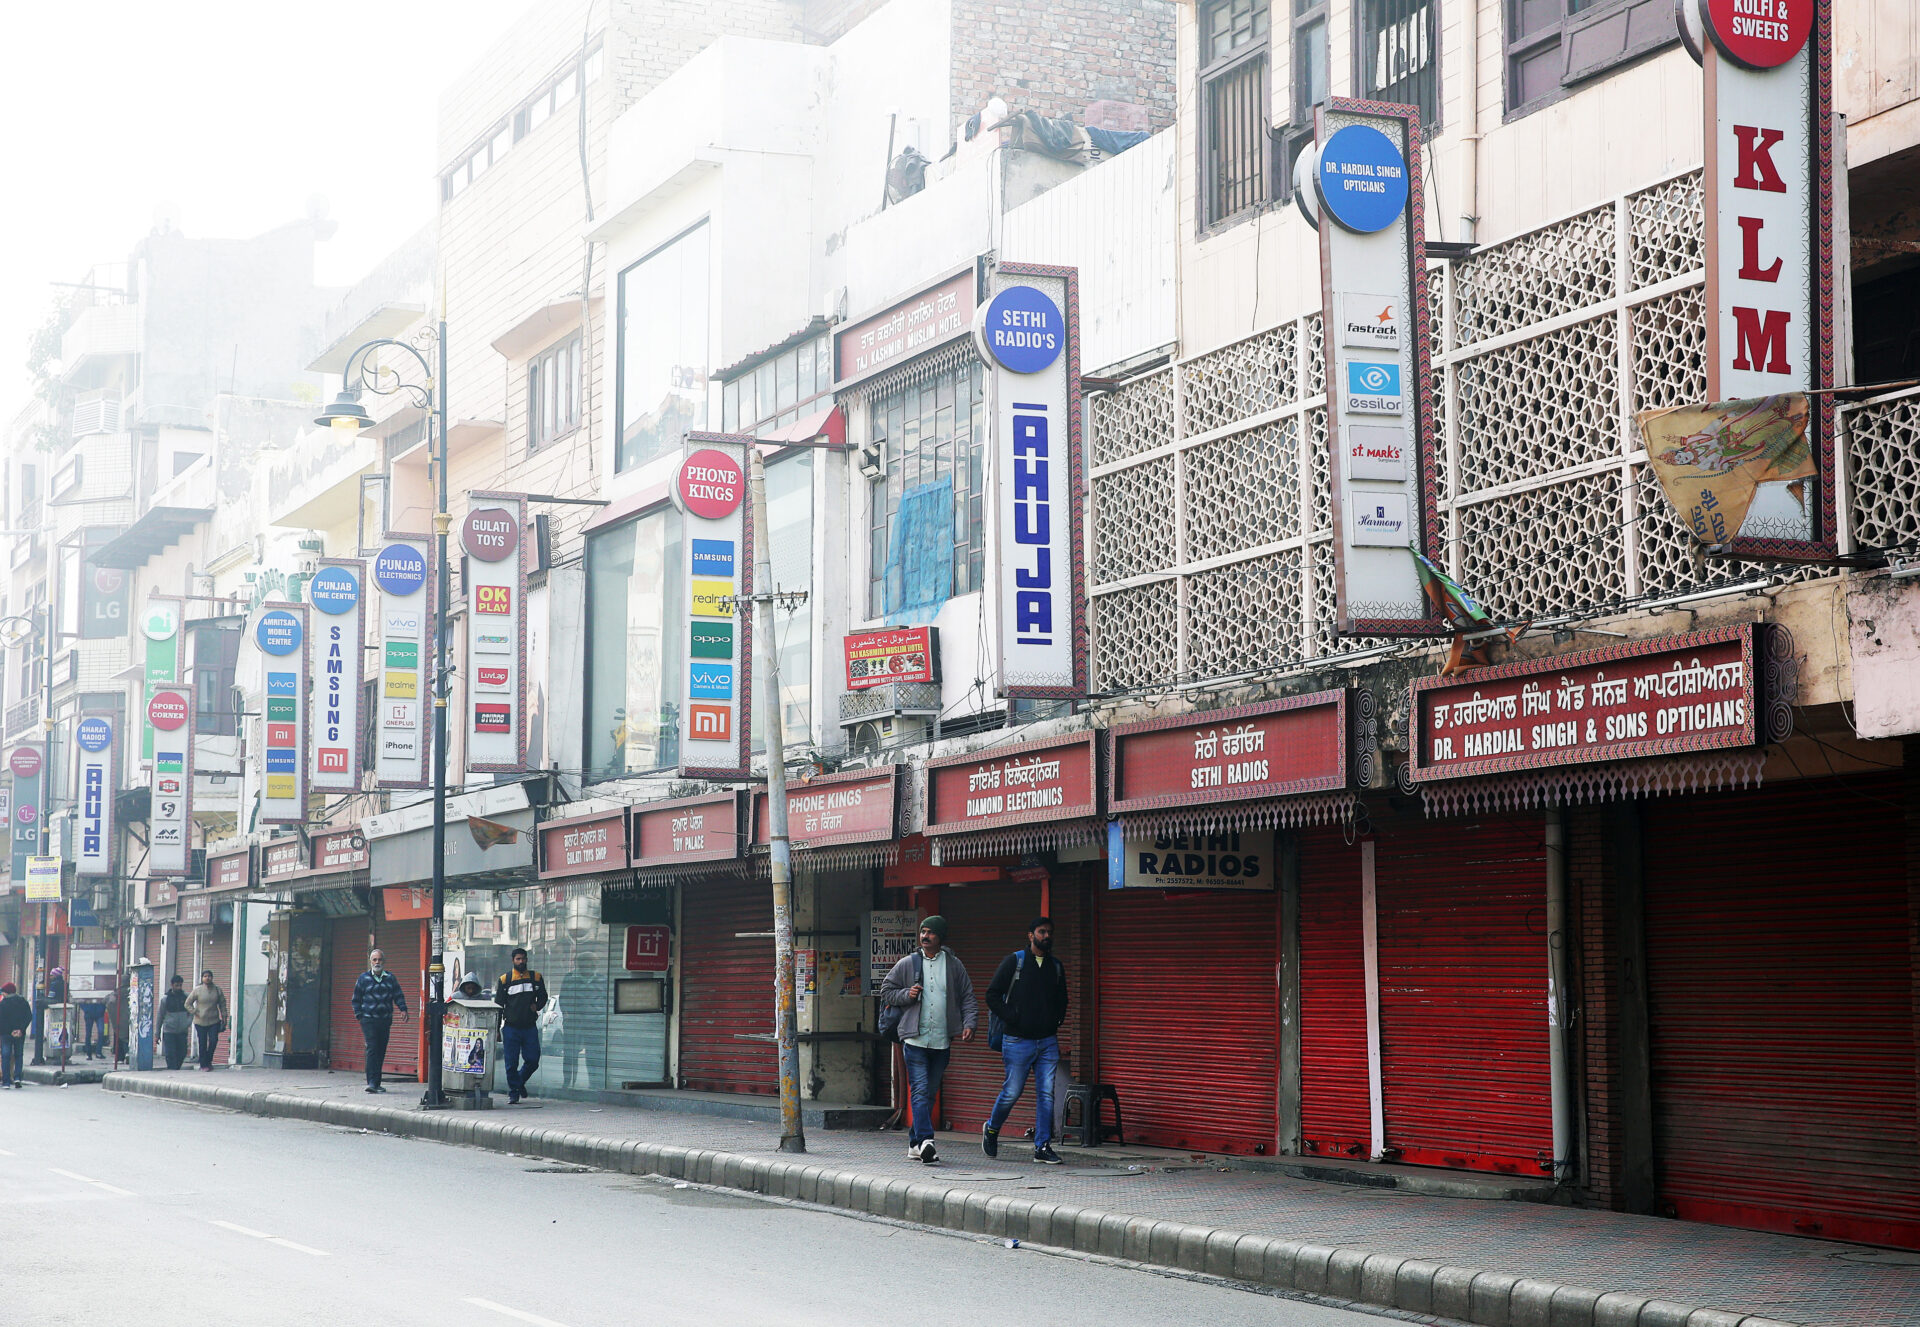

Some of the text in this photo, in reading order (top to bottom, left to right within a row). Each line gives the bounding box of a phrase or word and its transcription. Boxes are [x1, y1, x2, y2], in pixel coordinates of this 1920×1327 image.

[1734, 0, 1788, 20] KULFI &
[1732, 16, 1789, 42] SWEETS
[1325, 160, 1401, 179] DR. HARDIAL SINGH
[1343, 178, 1386, 194] OPTICIANS
[1002, 309, 1047, 328] SETHI
[1347, 322, 1397, 335] fastrack
[856, 311, 962, 373] TAJ KASHMIRI MUSLIM HOTEL
[995, 329, 1055, 350] RADIO'S
[1349, 397, 1400, 411] essilor
[687, 466, 737, 485] PHONE
[688, 482, 734, 502] KINGS
[472, 519, 510, 533] GULATI
[1012, 402, 1052, 646] AHUJA
[1358, 514, 1402, 532] Harmony
[477, 533, 505, 547] TOYS
[694, 552, 732, 562] SAMSUNG
[380, 558, 422, 571] PUNJAB
[379, 571, 422, 581] ELECTRONICS
[317, 581, 352, 592] PUNJAB
[313, 591, 356, 601] TIME CENTRE
[479, 587, 507, 602] OK
[95, 602, 120, 619] LG
[479, 602, 507, 613] PLAY
[263, 619, 296, 627] AMRITSAR
[389, 618, 417, 628] vivo
[267, 637, 292, 646] CENTRE
[693, 635, 731, 643] oppo
[269, 679, 295, 688] vivo
[327, 626, 343, 741] SAMSUNG
[693, 672, 730, 684] vivo
[386, 681, 415, 690] realme
[152, 703, 184, 711] SPORTS
[270, 705, 293, 713] oppo
[152, 711, 184, 720] CORNER
[81, 726, 107, 734] BHARAT
[1434, 699, 1745, 761] DR. HARDIAL SINGH & SONS OPTICIANS
[385, 741, 413, 750] iPhone
[267, 757, 295, 765] SAMSUNG
[1191, 759, 1269, 789] SETHI RADIOS
[789, 788, 862, 814] PHONE KINGS
[966, 786, 1063, 817] DIAMOND ELECTRONICS
[84, 764, 102, 857] AHUJA
[15, 828, 36, 841] LG
[673, 834, 704, 852] TOY PALACE
[567, 846, 607, 865] GULATI TOYS SHOP
[1139, 852, 1260, 877] RADIOS
[884, 938, 915, 955] FINANCE
